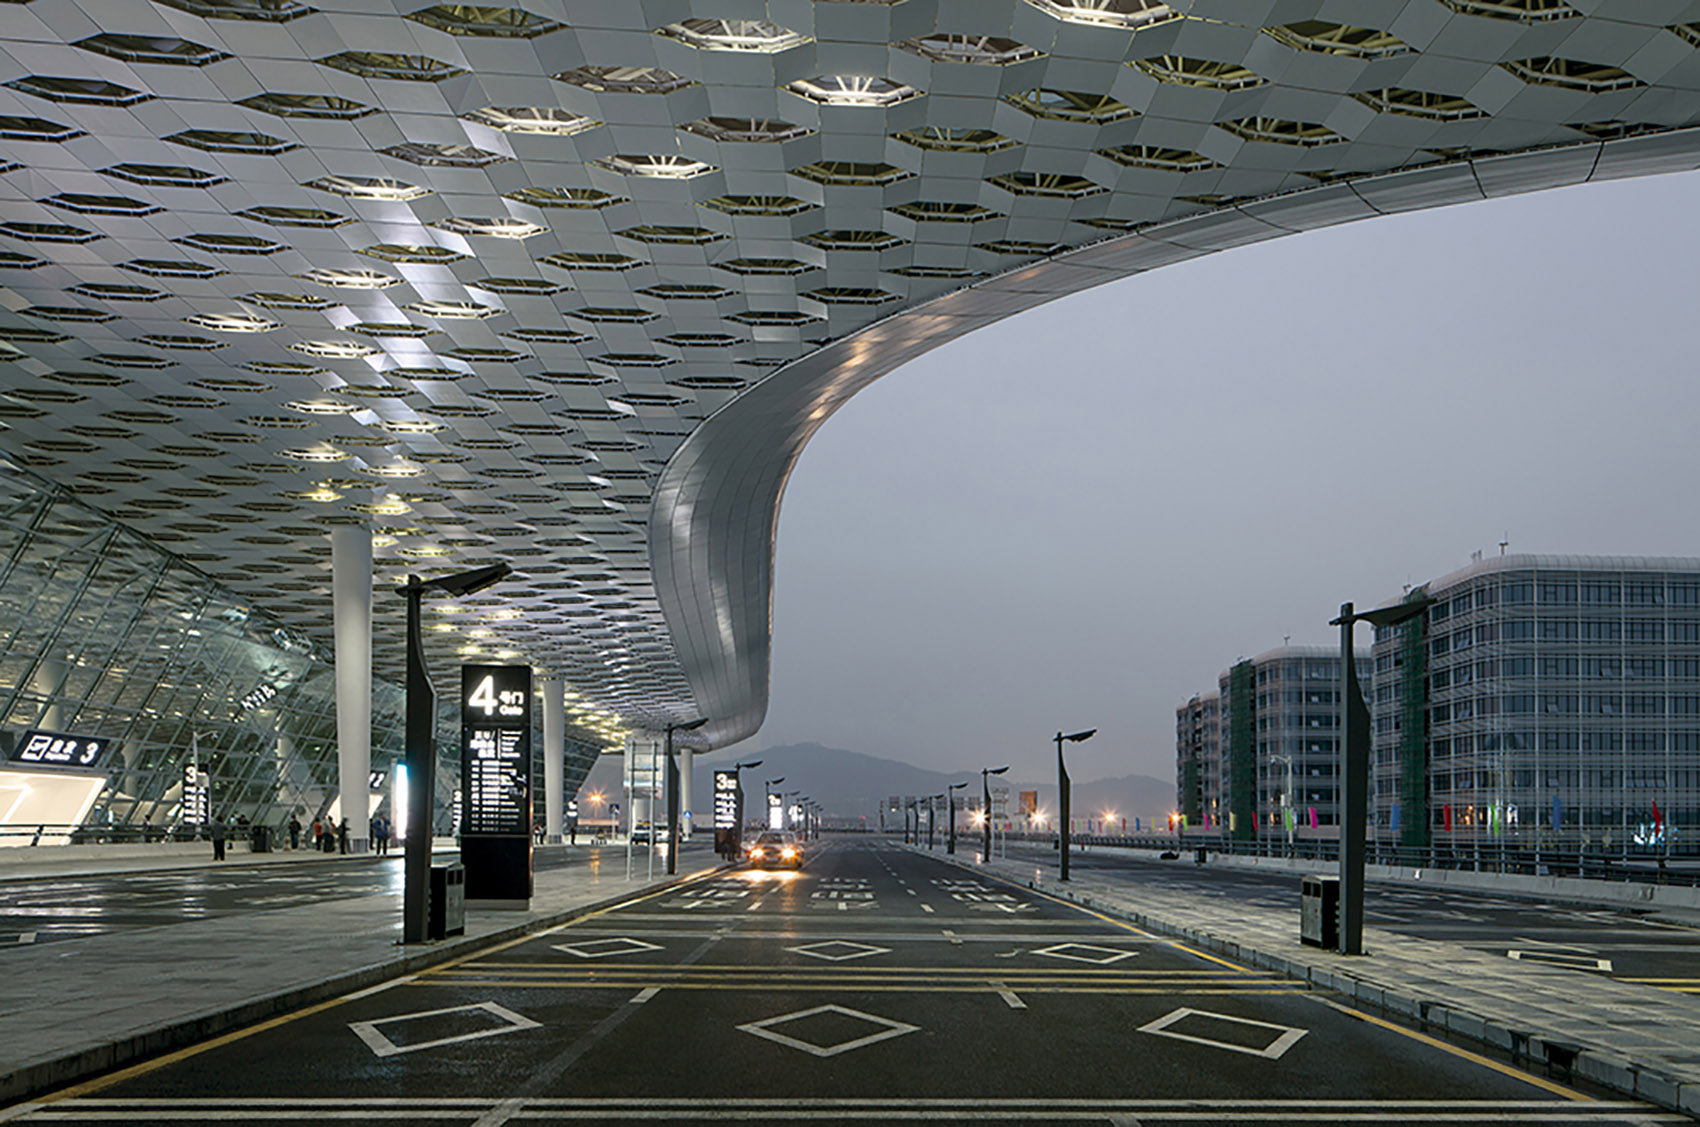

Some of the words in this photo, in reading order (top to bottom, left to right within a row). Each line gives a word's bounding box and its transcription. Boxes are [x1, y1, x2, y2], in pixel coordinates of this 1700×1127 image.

[468, 674, 499, 716] 4
[80, 742, 99, 764] 3
[185, 766, 197, 783] 3
[716, 773, 728, 790] 3
